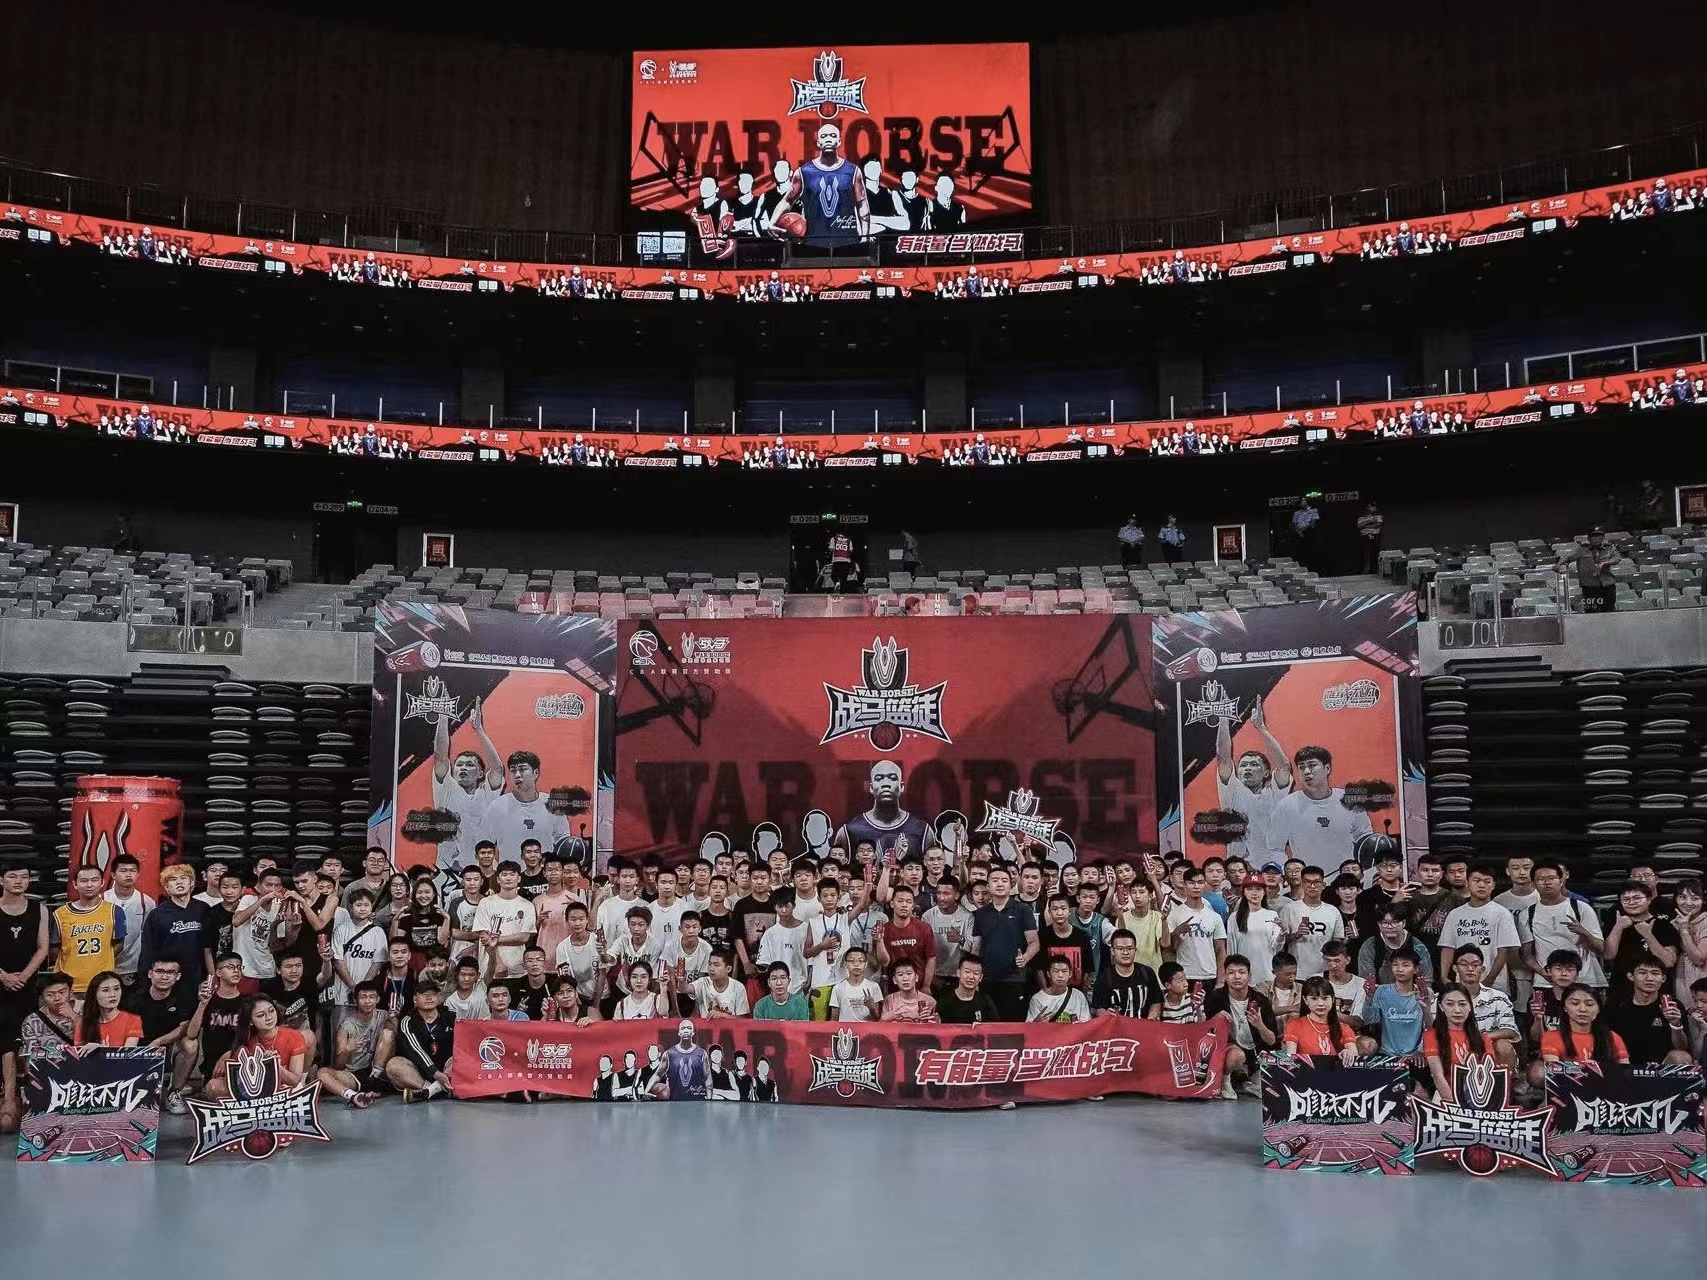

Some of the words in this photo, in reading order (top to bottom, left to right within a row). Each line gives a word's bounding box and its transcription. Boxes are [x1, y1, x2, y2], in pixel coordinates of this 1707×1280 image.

[657, 120, 789, 173] WAR
[896, 234, 951, 253] 有能量
[856, 688, 879, 697] WAR
[880, 688, 915, 698] HORSE
[828, 690, 945, 738] 战马篮徒
[71, 923, 105, 937] LAKERS
[77, 937, 102, 956] 23
[915, 1048, 1018, 1085] 有能量
[1013, 1038, 1140, 1082] 当燃战马
[224, 1099, 250, 1110] WAR
[251, 1094, 287, 1107] HORSE
[198, 1093, 320, 1149] 战马篮徒
[1449, 1107, 1475, 1118] WAR
[1476, 1109, 1514, 1120] HORSE
[1421, 1107, 1545, 1163] 战马篮徒
